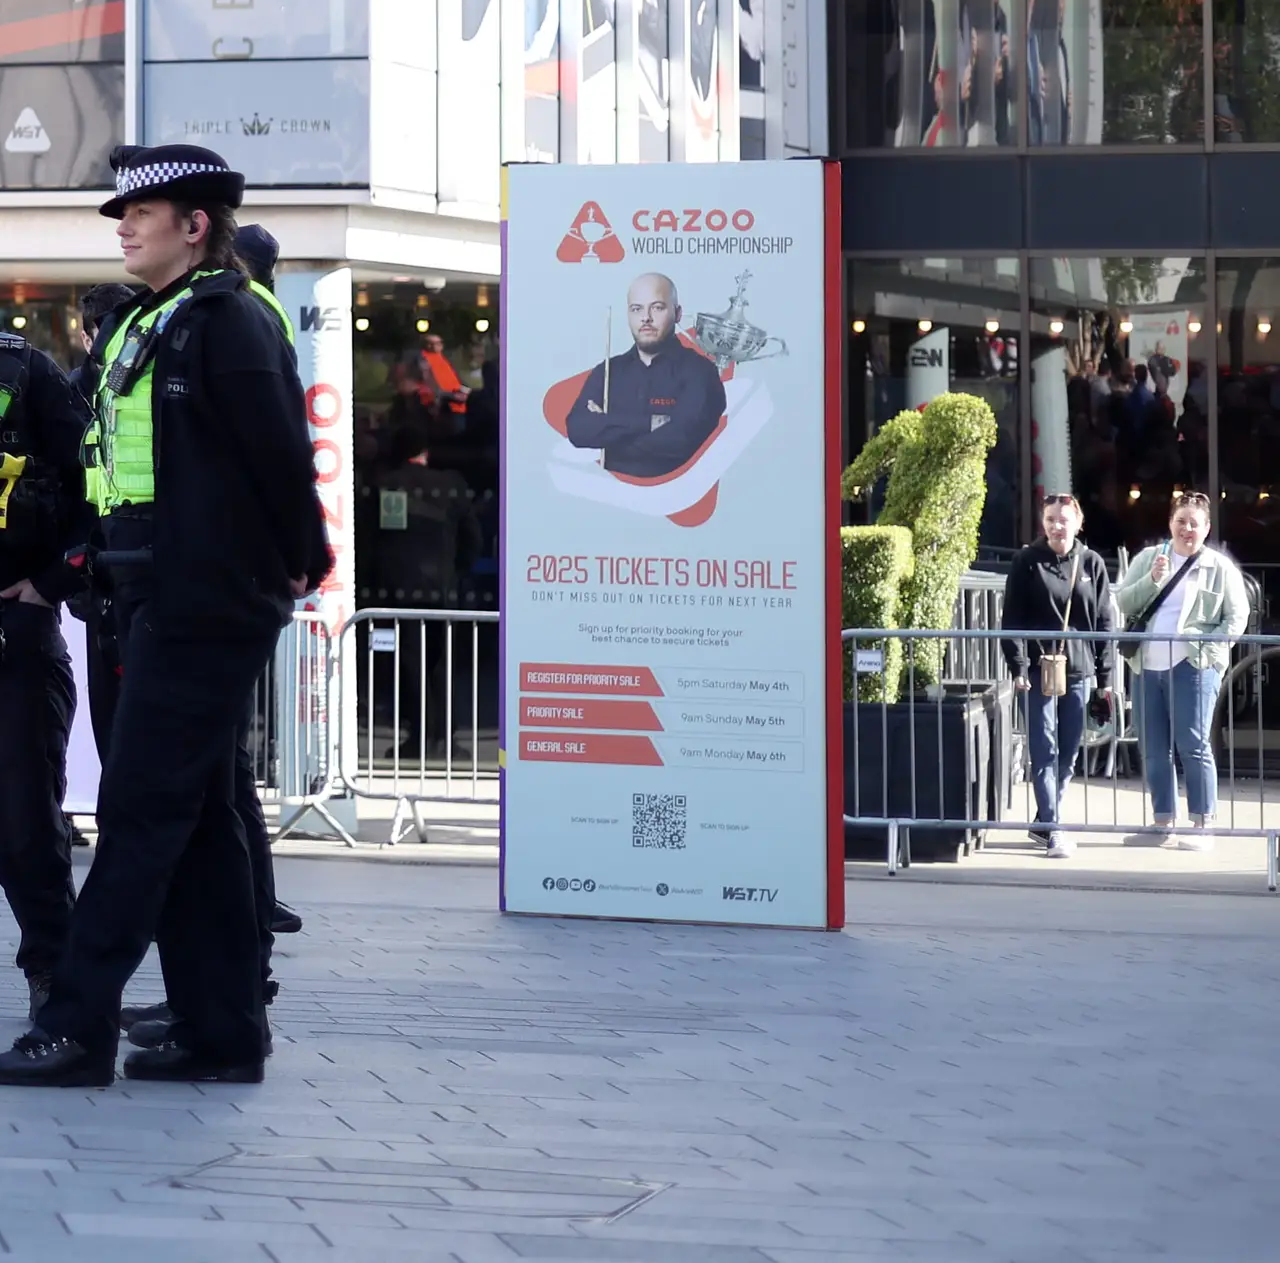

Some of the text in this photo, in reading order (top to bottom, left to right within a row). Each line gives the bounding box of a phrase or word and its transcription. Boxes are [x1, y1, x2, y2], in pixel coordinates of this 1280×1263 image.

[184, 119, 332, 135] TRIPLE CROWN
[632, 209, 755, 232] CAZOO
[632, 237, 793, 255] WORLD CHAMPIONSHIP
[527, 555, 798, 591] 2025 TICKETS ON SALE
[532, 591, 793, 609] DON'T MISS OUT ON TICKETS FOR NEXT YEAR
[578, 624, 743, 640] Sign up for priority booking for your
[592, 634, 729, 647] best chance to secure tickets
[527, 672, 640, 687] REGISTER FOR PRIORITY SALE
[677, 679, 789, 693] 5pm Saturday May 4th
[527, 706, 584, 719] PRIORITY SALE
[681, 713, 785, 727] 9am Sunday May 5th
[527, 741, 586, 754] GENERAL SALE
[680, 748, 786, 762] 9am Monday May 6th
[722, 887, 779, 902] WST.TV
